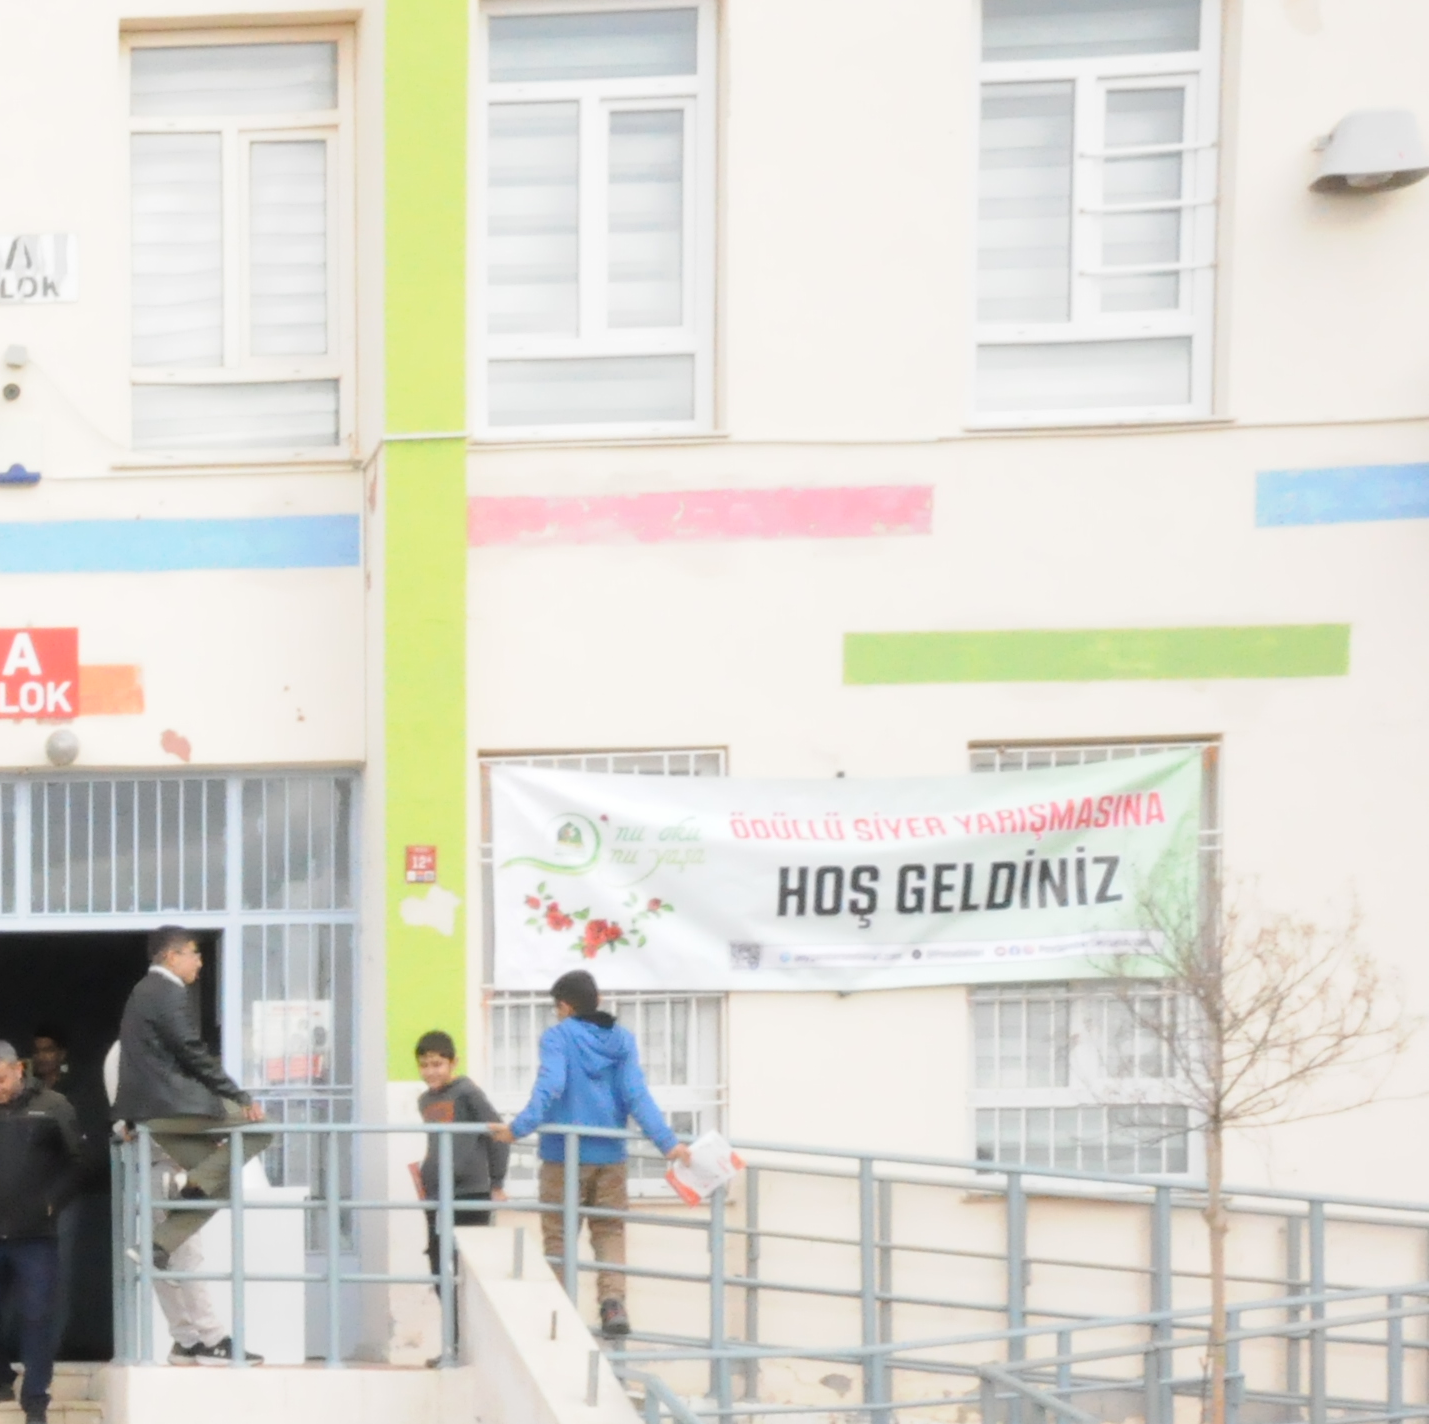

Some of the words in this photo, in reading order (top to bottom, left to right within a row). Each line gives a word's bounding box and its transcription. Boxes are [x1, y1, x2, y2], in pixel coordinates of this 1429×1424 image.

[2, 632, 42, 676] A
[729, 812, 845, 841] ÖDÜLLÜ
[854, 811, 946, 842] SİYER
[953, 792, 1167, 841] YARIŞMASINA
[775, 863, 881, 929] HOŞ
[894, 846, 1124, 915] GELDİNİZ
